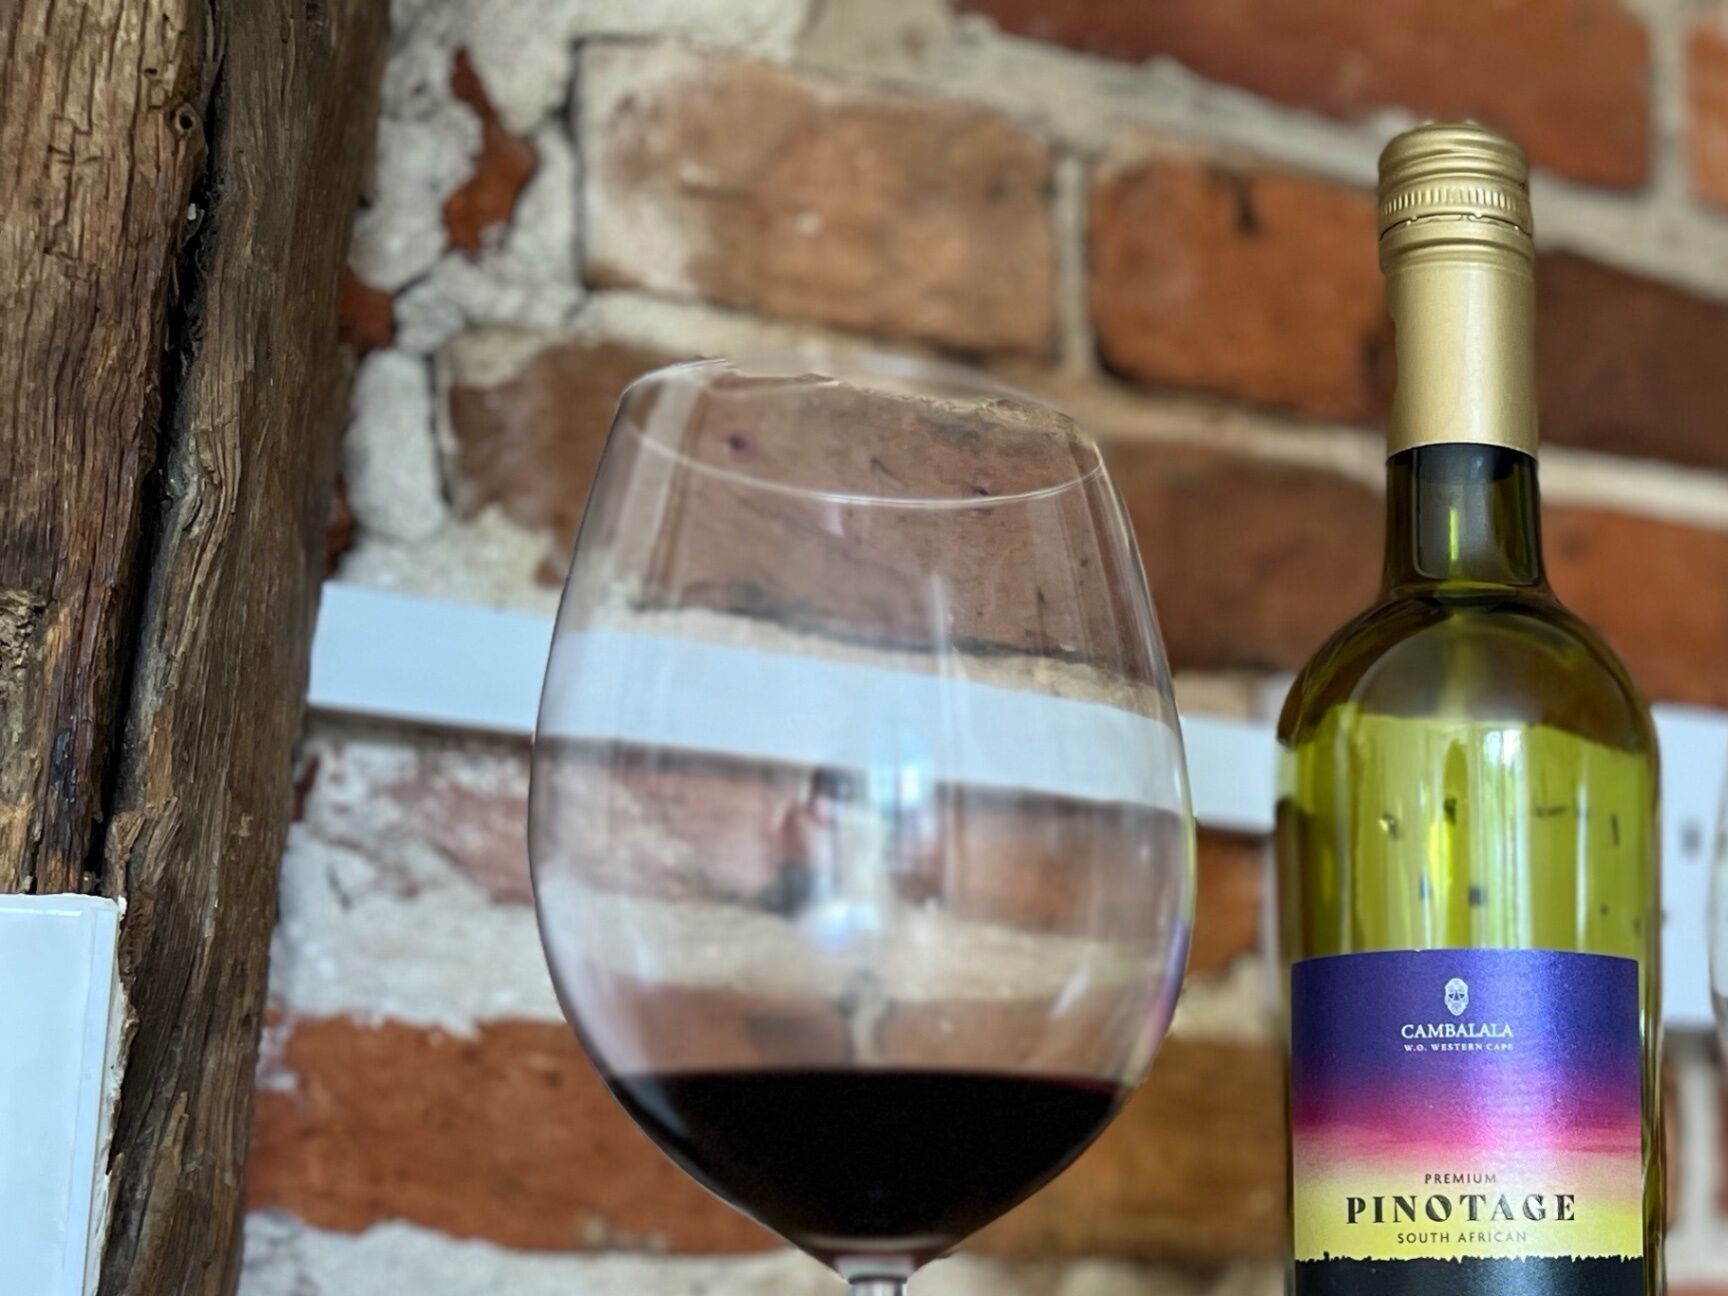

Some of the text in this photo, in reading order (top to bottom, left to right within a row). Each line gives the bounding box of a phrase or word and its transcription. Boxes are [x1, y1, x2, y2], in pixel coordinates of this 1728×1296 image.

[1401, 1023, 1514, 1039] CAMBALALA
[1404, 1042, 1513, 1052] W.O. WESTERN CAPE
[1424, 1173, 1497, 1184] PREMIUM
[1346, 1193, 1575, 1225] PINOTAGE
[1397, 1231, 1527, 1244] SOUTH AFRICAN
